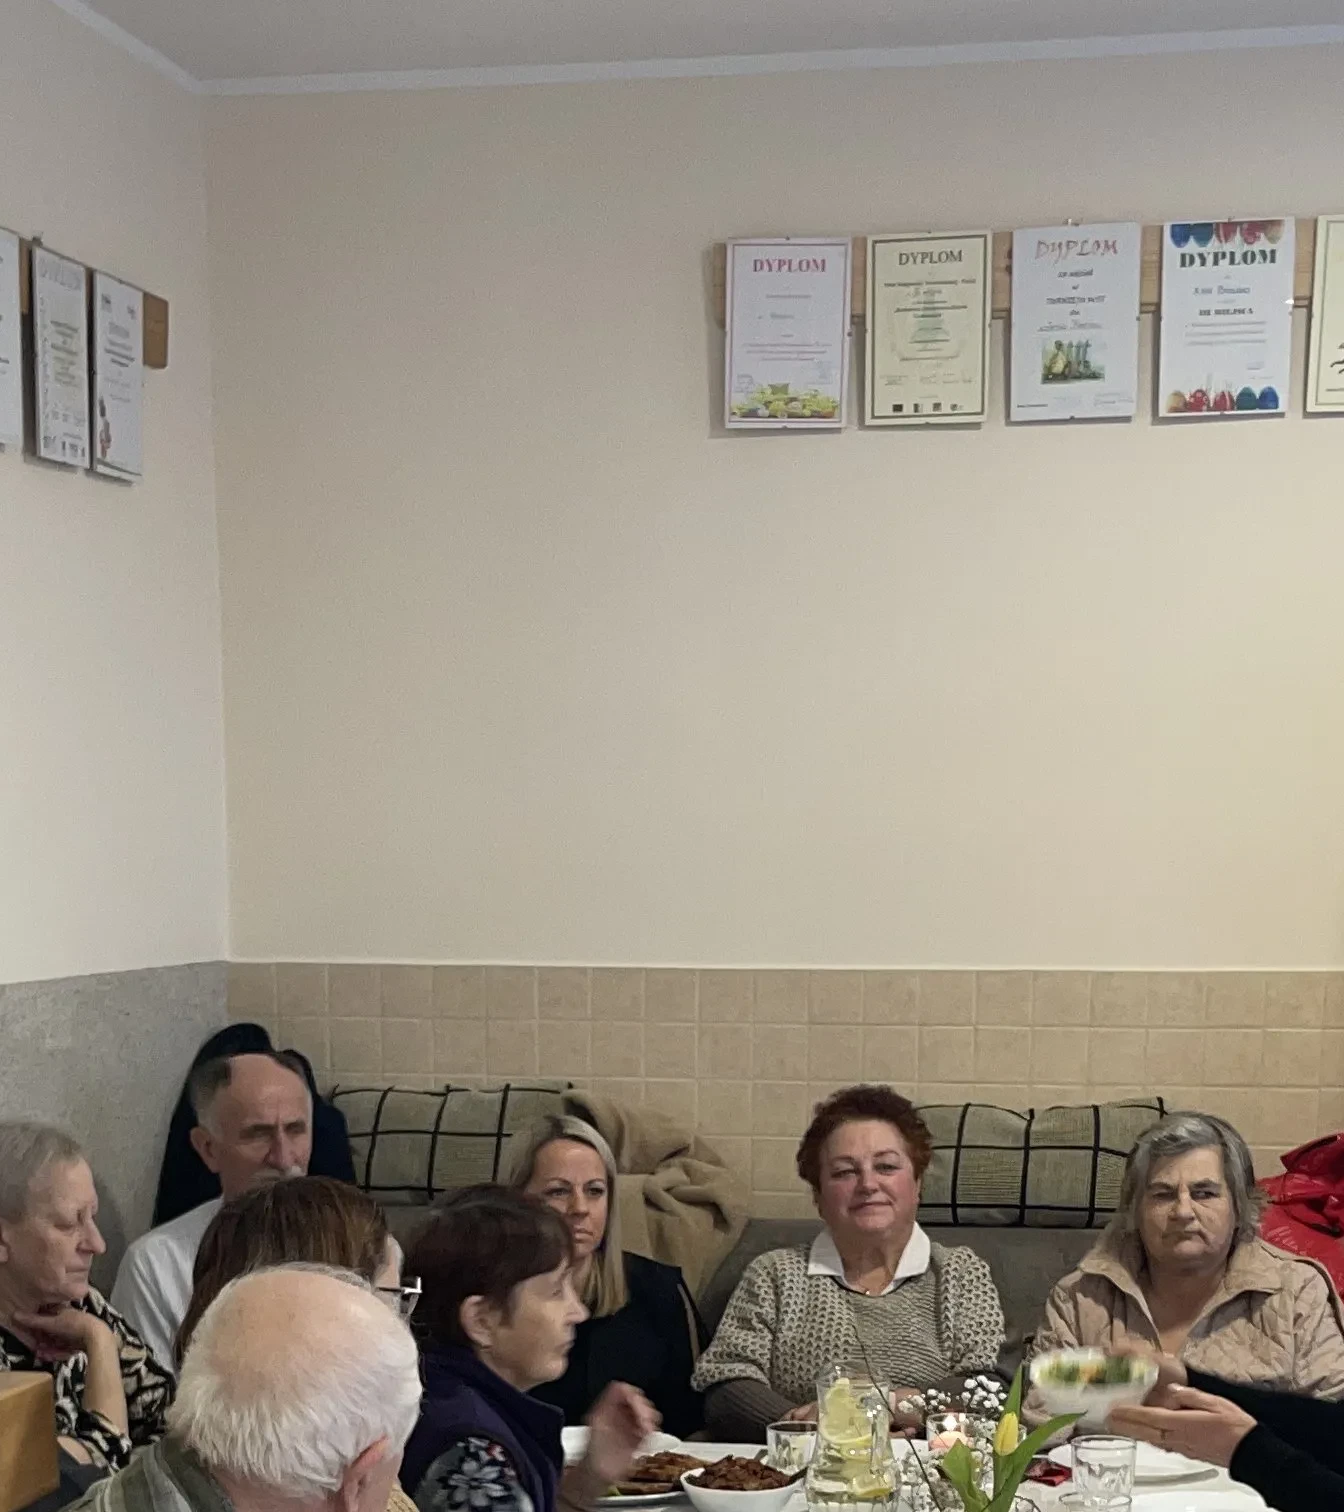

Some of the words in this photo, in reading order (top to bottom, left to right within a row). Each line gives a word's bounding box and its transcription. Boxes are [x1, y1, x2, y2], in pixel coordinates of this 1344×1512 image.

[898, 250, 963, 266] DYPLOM
[1035, 239, 1119, 265] DYPLOM
[1179, 248, 1277, 268] DYPLOM
[753, 258, 827, 273] DYPLOM
